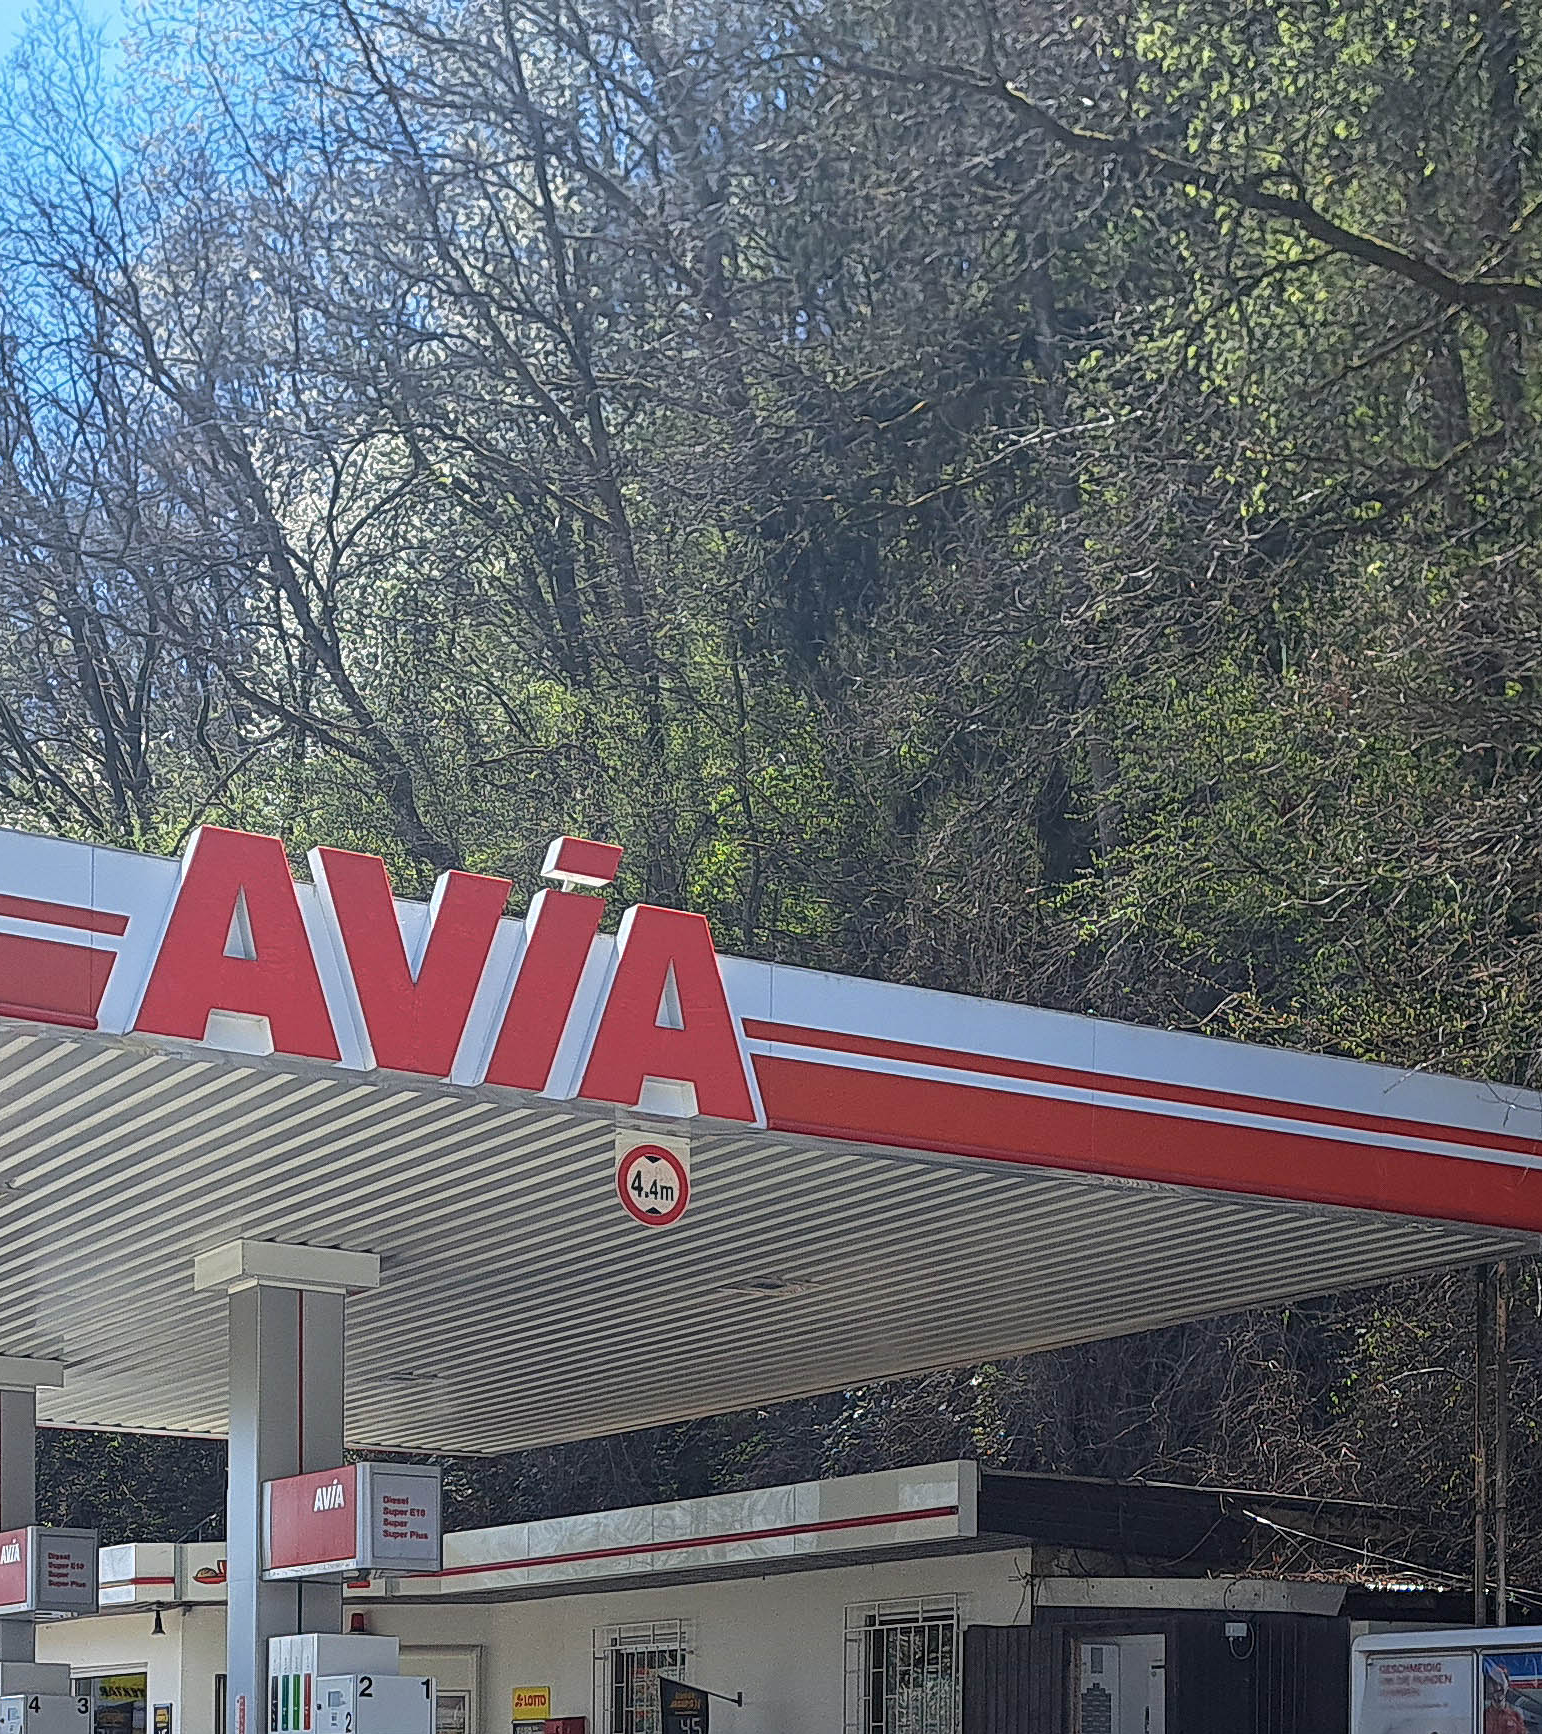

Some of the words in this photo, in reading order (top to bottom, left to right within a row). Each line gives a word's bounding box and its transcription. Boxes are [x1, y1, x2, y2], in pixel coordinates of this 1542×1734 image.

[131, 822, 757, 1124] AVIA
[382, 1495, 410, 1505] Diesel
[382, 1507, 408, 1517] Super
[382, 1518, 408, 1528] Super
[382, 1529, 408, 1539] Super
[358, 1676, 374, 1698] 2
[420, 1678, 430, 1700] 1
[28, 1696, 41, 1714] 4
[77, 1697, 89, 1715] 3
[523, 1694, 547, 1707] LOTTO
[345, 1711, 353, 1734] 2
